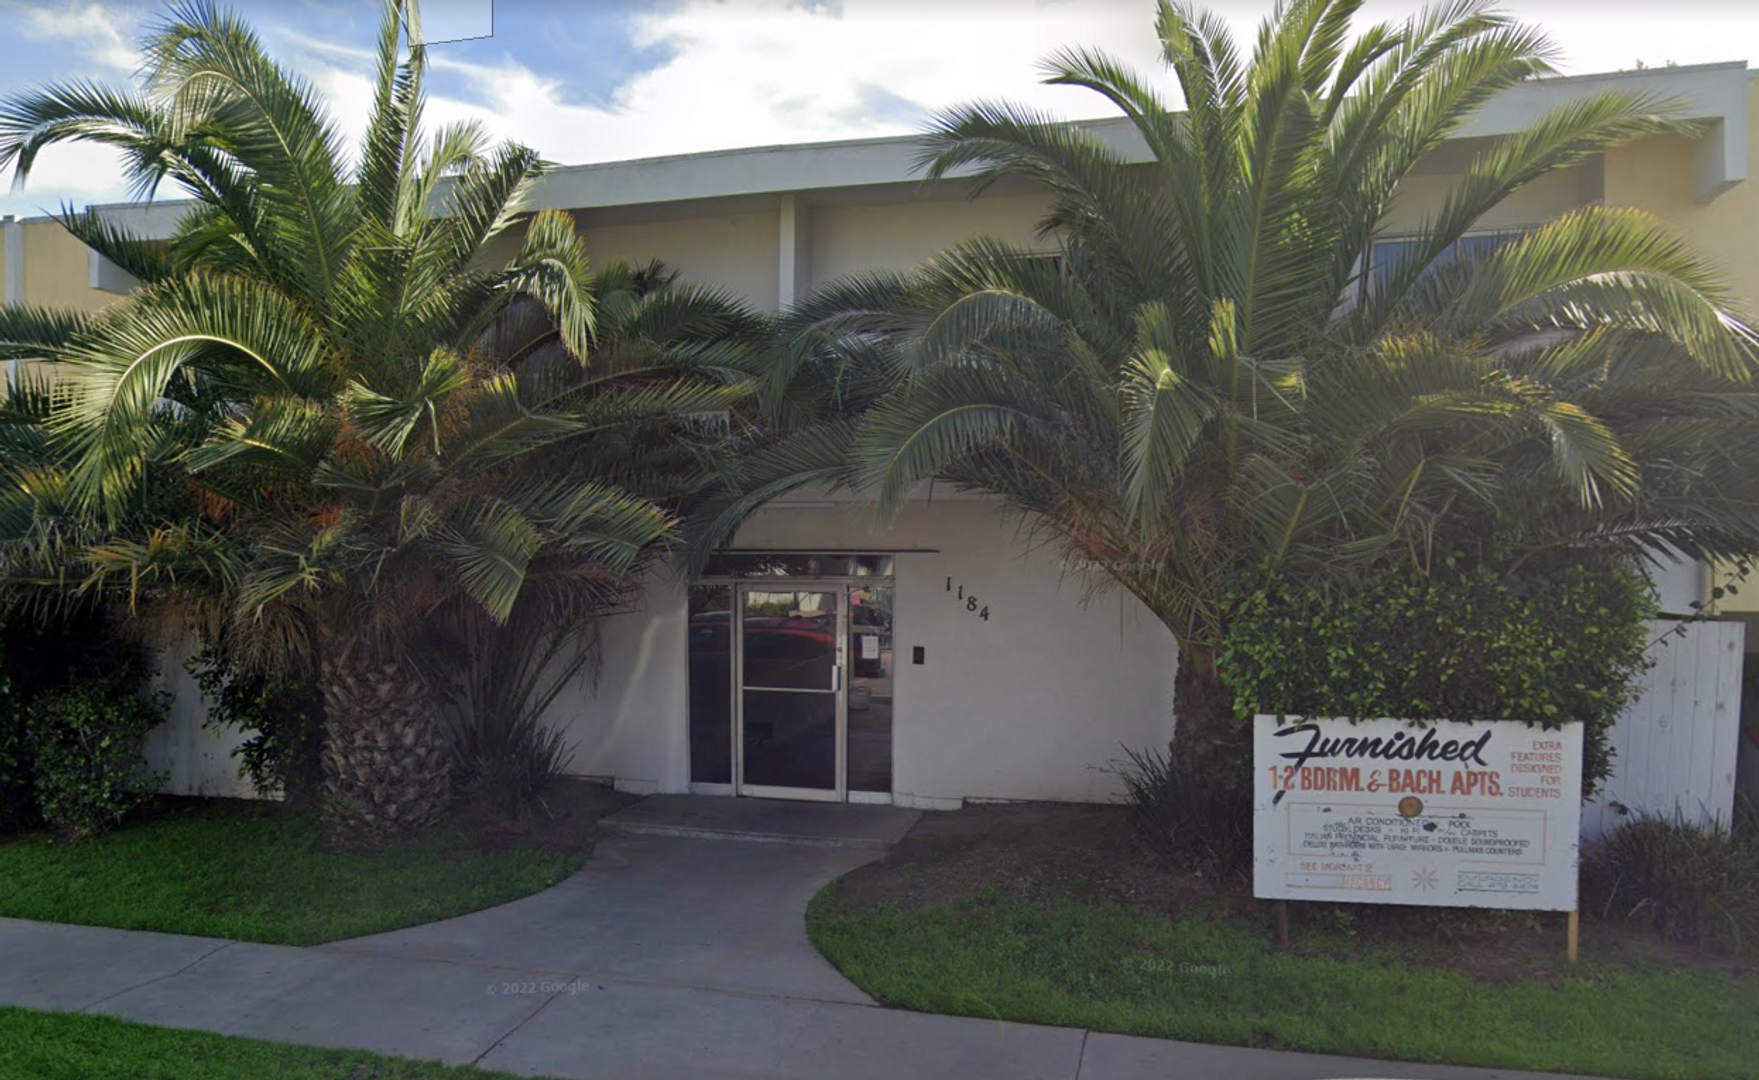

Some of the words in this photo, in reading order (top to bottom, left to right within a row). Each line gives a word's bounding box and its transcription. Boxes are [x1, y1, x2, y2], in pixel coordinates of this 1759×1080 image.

[946, 576, 989, 621] 1184
[1533, 741, 1562, 751] EXTRA
[1273, 723, 1492, 804] Furnished
[1511, 752, 1562, 763] FEATURES
[1511, 763, 1562, 774] DESIGNED
[1300, 765, 1365, 792] BDRM.
[1367, 770, 1387, 792] &
[1388, 769, 1446, 795] BACH.
[1450, 771, 1504, 797] APTS.
[1541, 775, 1561, 786] FOR
[1508, 786, 1562, 798] STUDENTS
[1348, 817, 1363, 825] AIR
[1365, 817, 1429, 827] CONDITIONED
[1448, 820, 1472, 829] POOL
[1353, 825, 1382, 834] DESKS
[1460, 829, 1498, 839] CARPETS
[1304, 832, 1333, 841] ITALIAN
[1335, 832, 1380, 842] PROVINCIAL
[1383, 834, 1430, 844] FURNITURE
[1437, 837, 1468, 846] DOUBLE
[1470, 838, 1530, 848] SOUNDPROOFED
[1368, 842, 1385, 850] WITH
[1386, 843, 1407, 851] LARGE
[1411, 844, 1443, 853] MIRRORS
[1452, 845, 1484, 854] PULLMAN
[1485, 847, 1523, 855] COUNTERS
[1300, 861, 1318, 871] SEE
